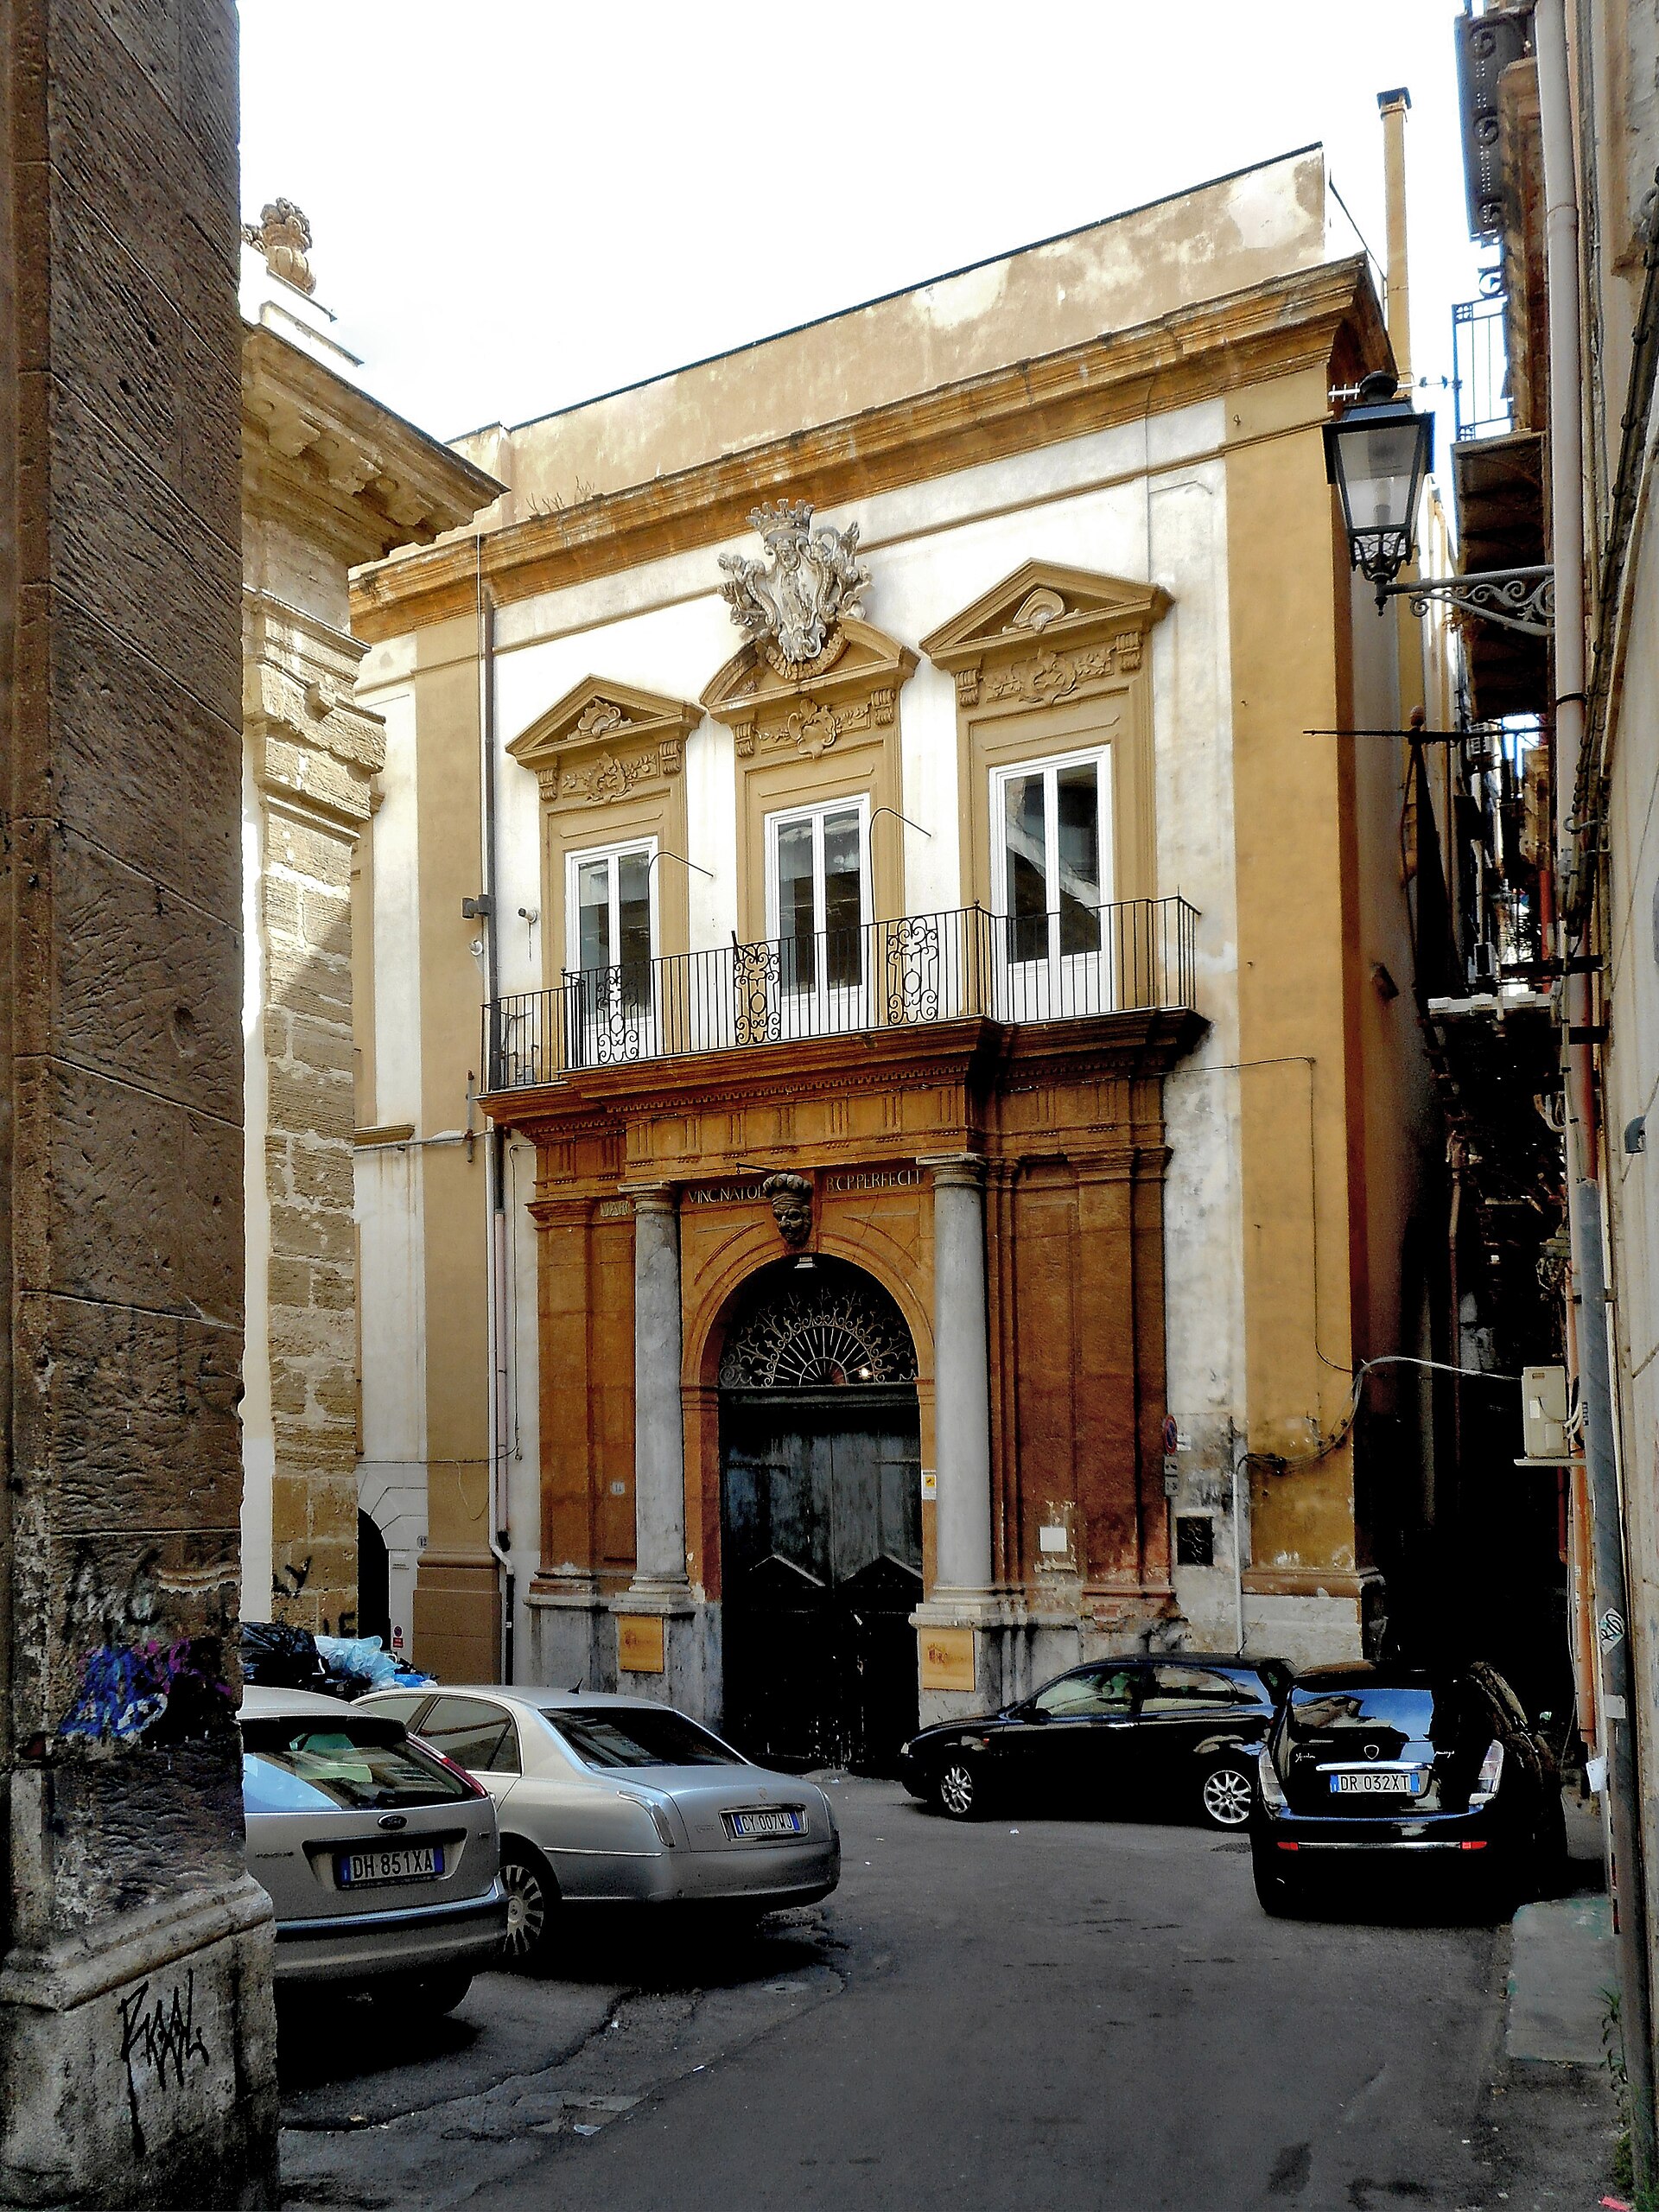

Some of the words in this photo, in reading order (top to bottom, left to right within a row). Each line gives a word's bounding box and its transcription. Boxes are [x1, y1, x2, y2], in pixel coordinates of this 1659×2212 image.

[1340, 1776, 1358, 1791] DR
[1364, 1774, 1409, 1790] 032XT
[742, 1815, 756, 1831] CY
[759, 1814, 792, 1830] 007WJ
[352, 1854, 375, 1878] DH
[380, 1849, 434, 1876] 851XA
